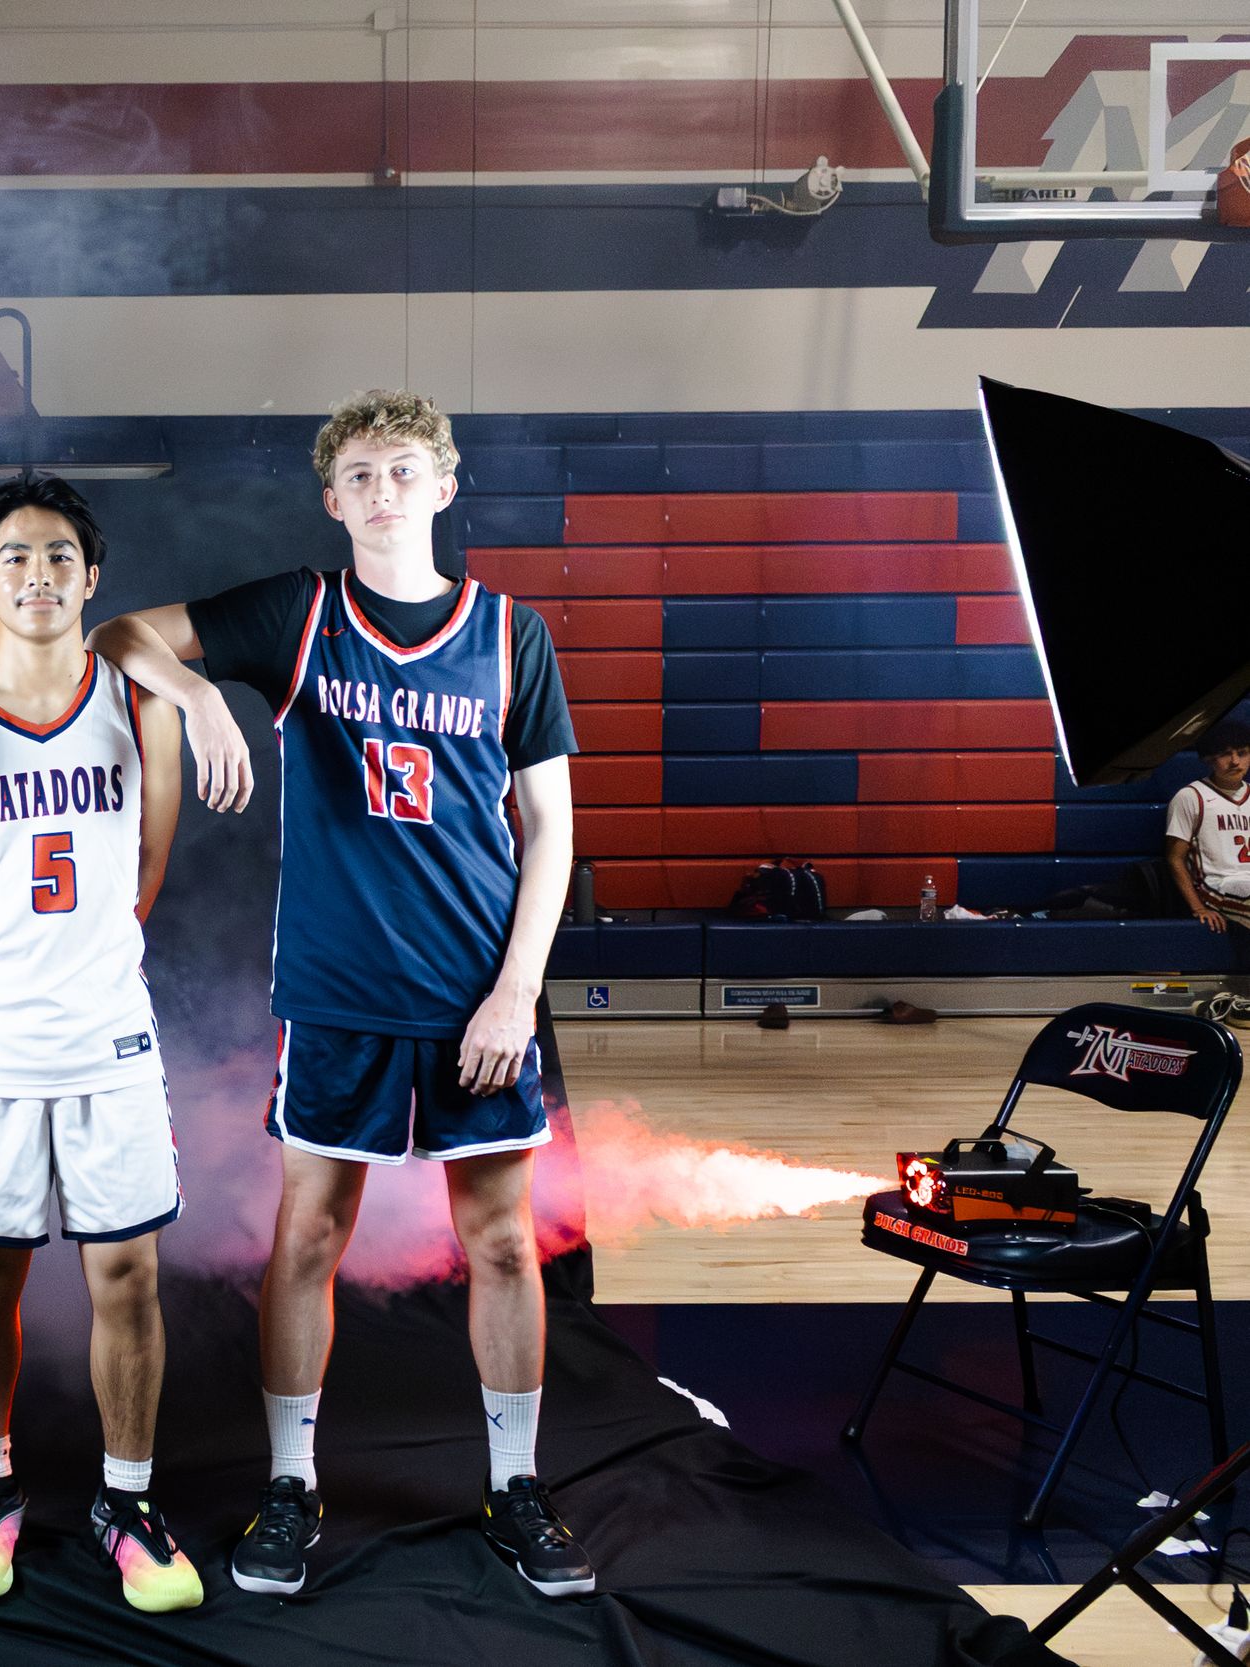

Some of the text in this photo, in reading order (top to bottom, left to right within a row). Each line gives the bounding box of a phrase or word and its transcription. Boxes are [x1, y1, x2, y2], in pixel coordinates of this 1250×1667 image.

[318, 674, 485, 738] BOLSA GRANDE
[362, 737, 434, 825] 13
[1216, 813, 1250, 831] MATAD
[31, 831, 78, 914] 5
[874, 1211, 969, 1256] BOLSA GRANDE
